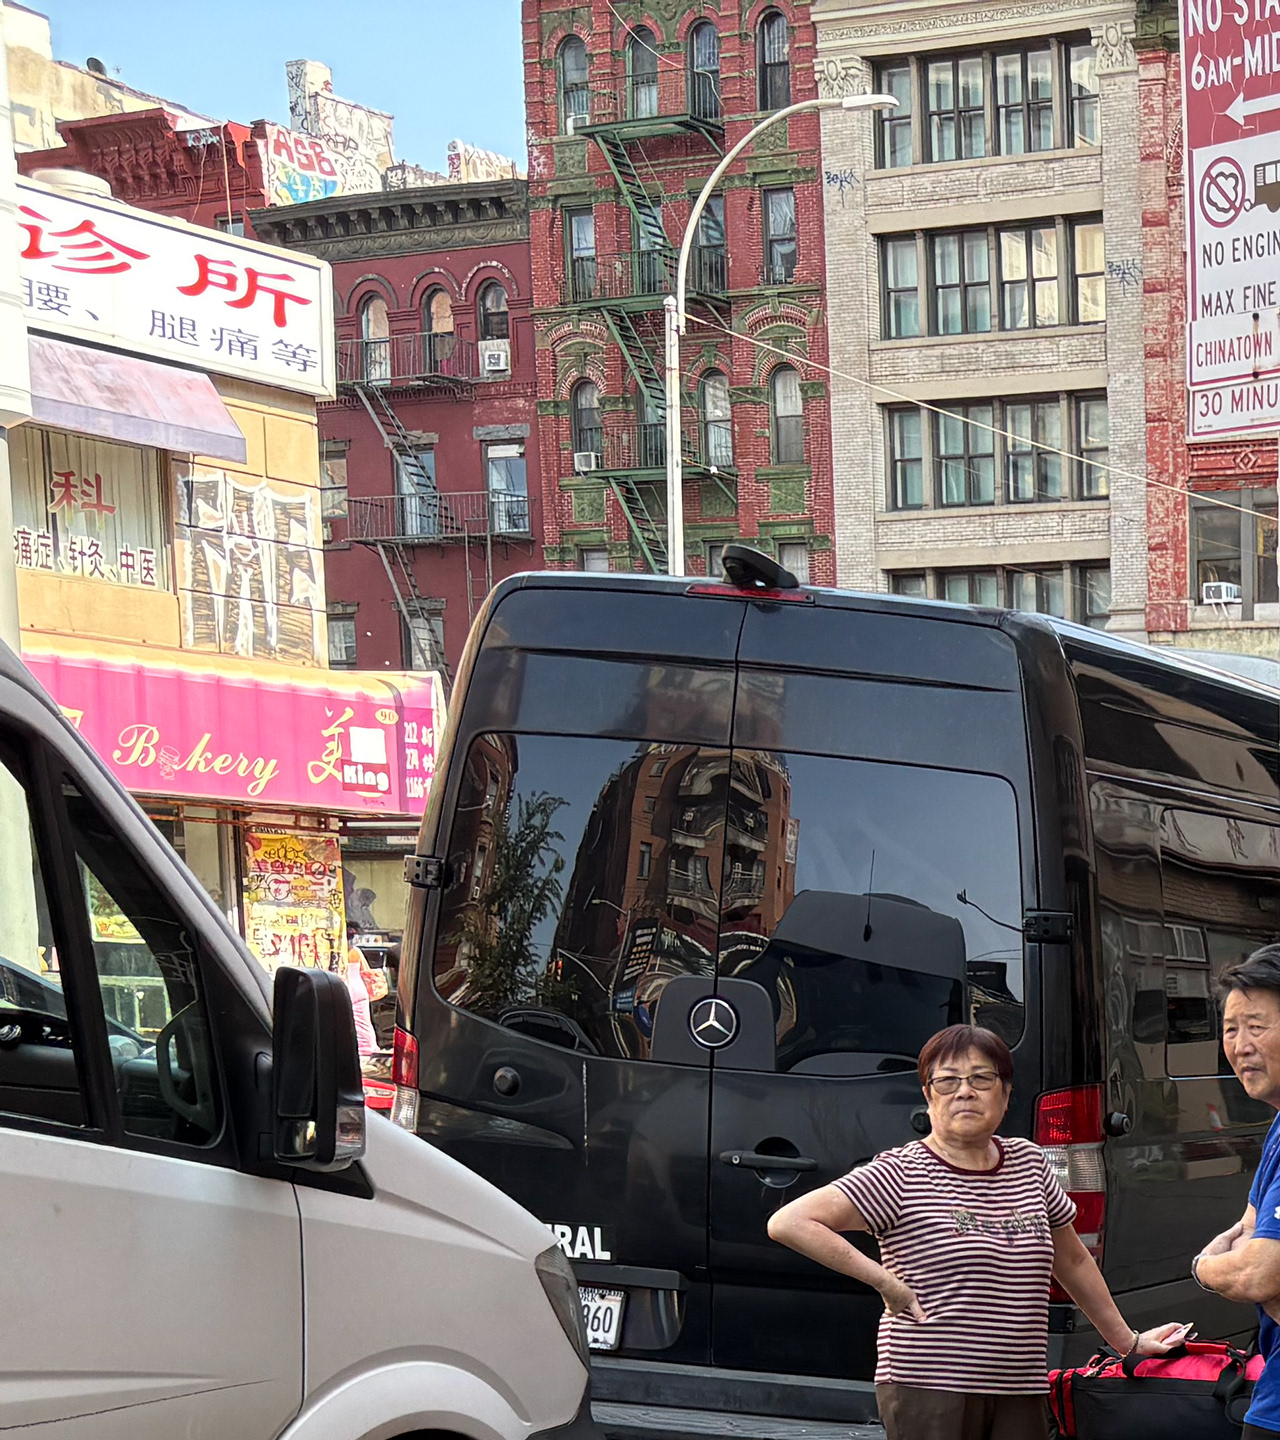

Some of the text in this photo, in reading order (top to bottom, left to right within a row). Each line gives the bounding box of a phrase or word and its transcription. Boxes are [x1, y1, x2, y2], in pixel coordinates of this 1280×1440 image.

[17, 205, 313, 328] 诊所
[1202, 241, 1225, 268] NO
[1202, 288, 1235, 319] MAX
[1243, 281, 1277, 310] FINE
[1196, 333, 1273, 368] CHINATOWN
[1199, 393, 1223, 418] 30
[49, 470, 117, 532] 科
[112, 724, 279, 796] Bkery
[343, 764, 389, 791] King
[545, 1224, 611, 1260] RAL
